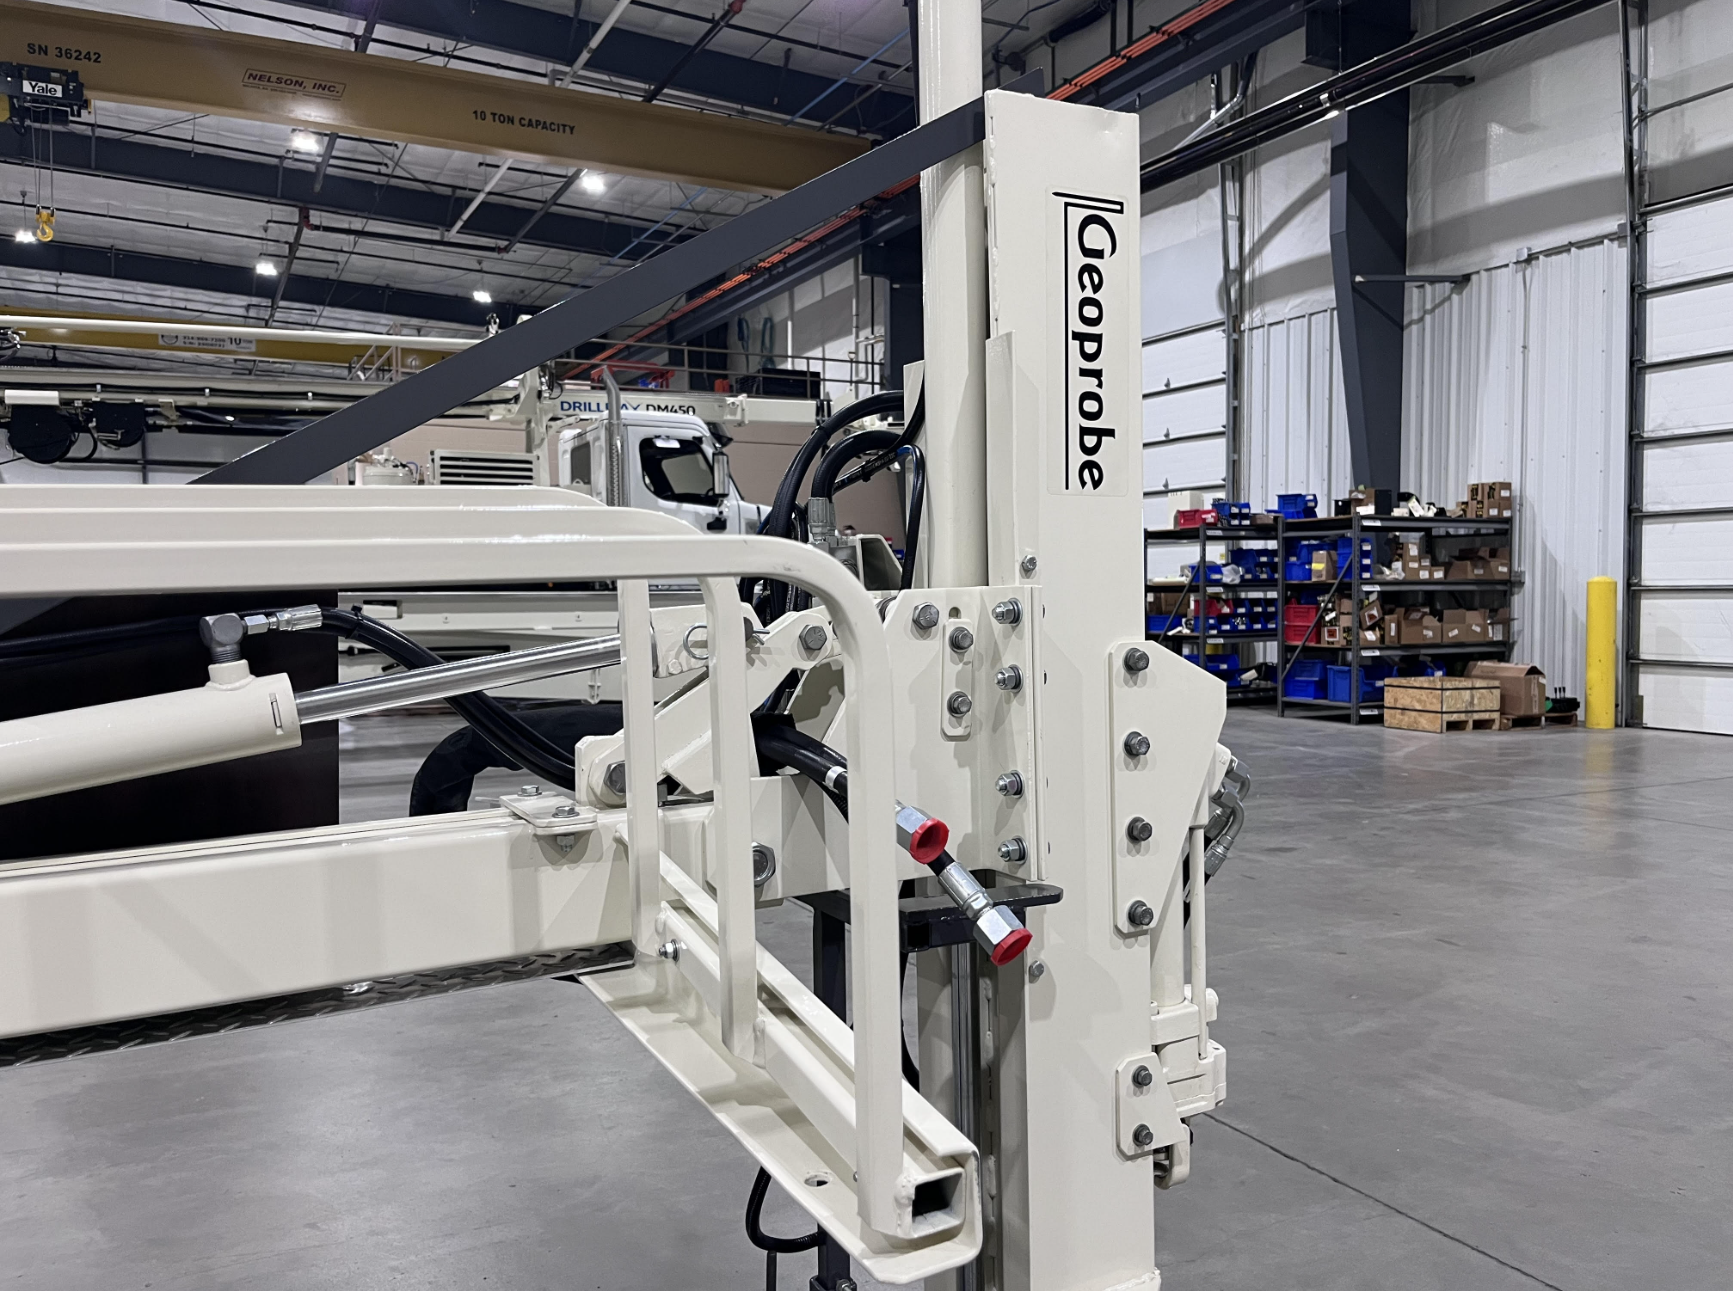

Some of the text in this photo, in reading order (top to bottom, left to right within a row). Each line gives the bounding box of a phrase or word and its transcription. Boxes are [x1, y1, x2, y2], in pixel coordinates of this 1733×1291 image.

[27, 42, 101, 63] SN 36242
[28, 81, 57, 96] Yale
[247, 72, 307, 90] NELSON,
[312, 82, 340, 94] INC.
[472, 110, 576, 135] 10 TON CAPACITY
[1071, 213, 1117, 491] Geoprobe
[560, 400, 696, 416] DRILLAX DM450
